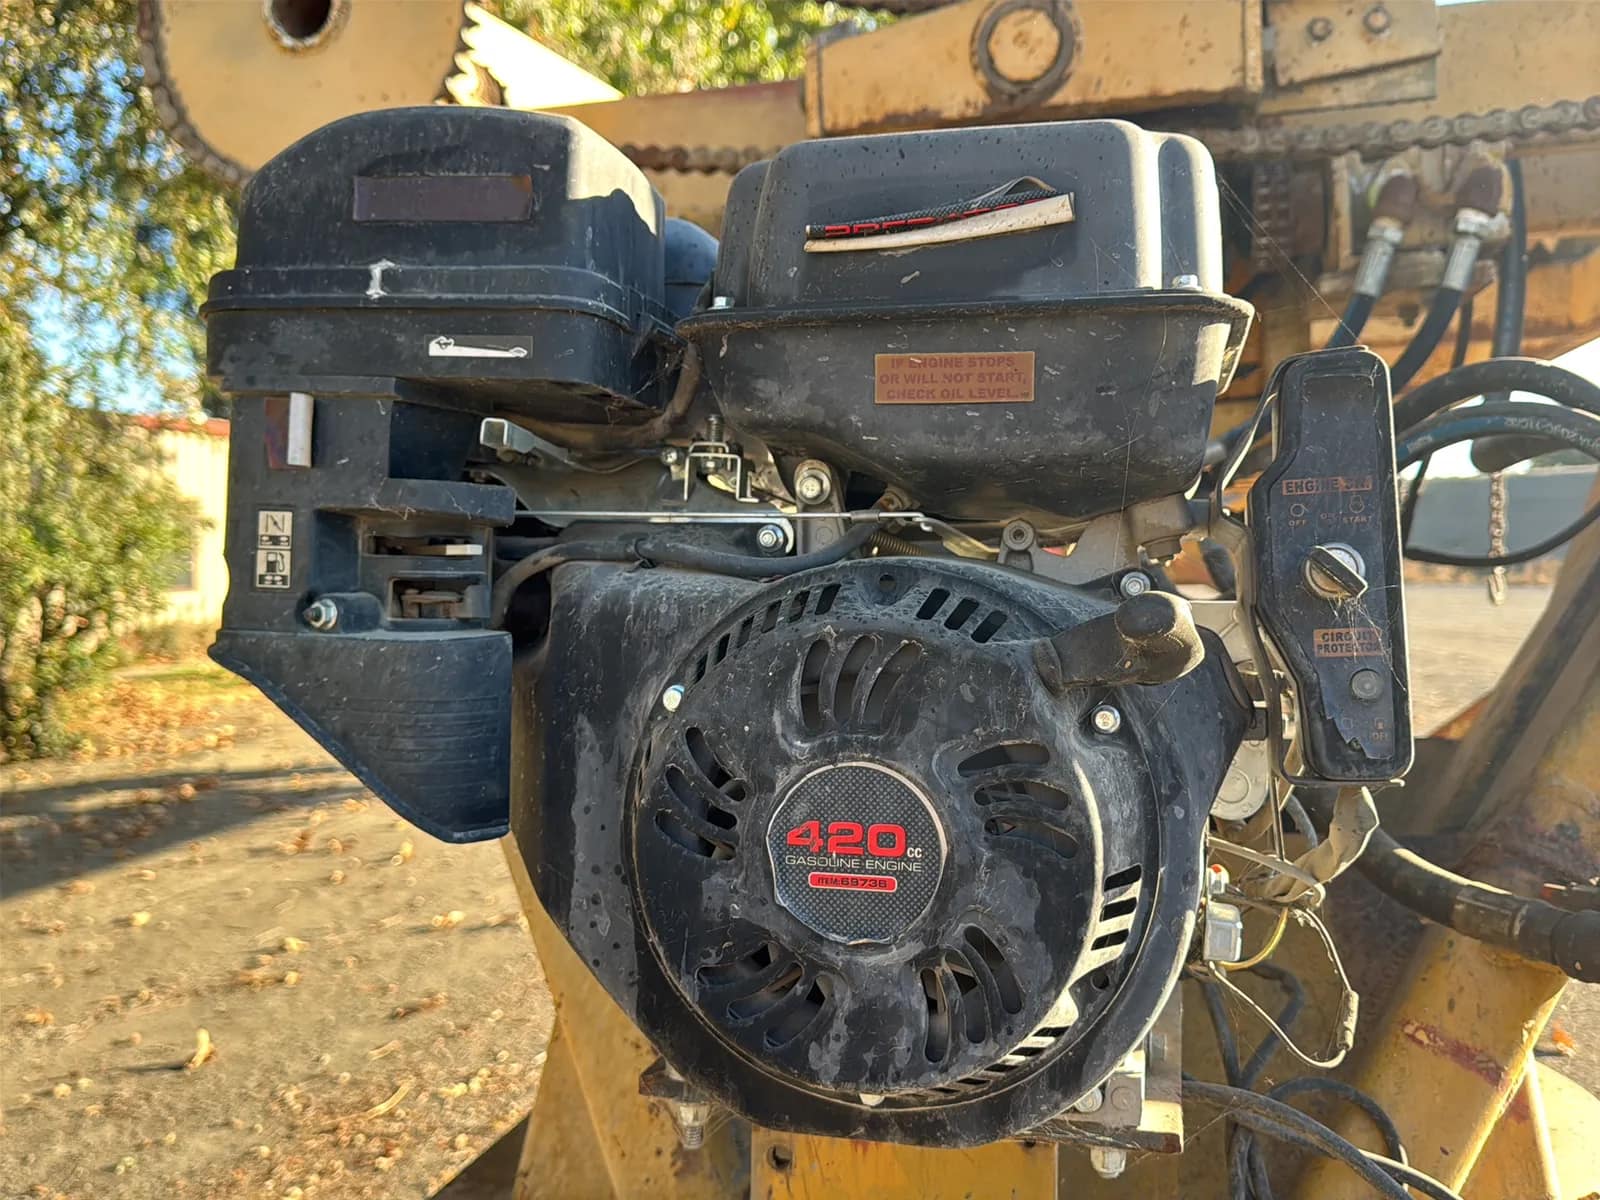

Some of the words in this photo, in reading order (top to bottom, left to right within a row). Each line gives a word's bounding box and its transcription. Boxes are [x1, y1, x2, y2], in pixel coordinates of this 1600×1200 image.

[891, 359, 903, 369] IF
[908, 357, 963, 369] ENGINE
[879, 374, 899, 385] OR
[904, 374, 938, 384] WILL
[943, 373, 971, 384] NOT
[886, 389, 936, 399] CHECK
[940, 389, 963, 399] OIL
[787, 820, 907, 857] 420
[785, 855, 861, 869] GASOLINE
[865, 860, 922, 872] ENGINE
